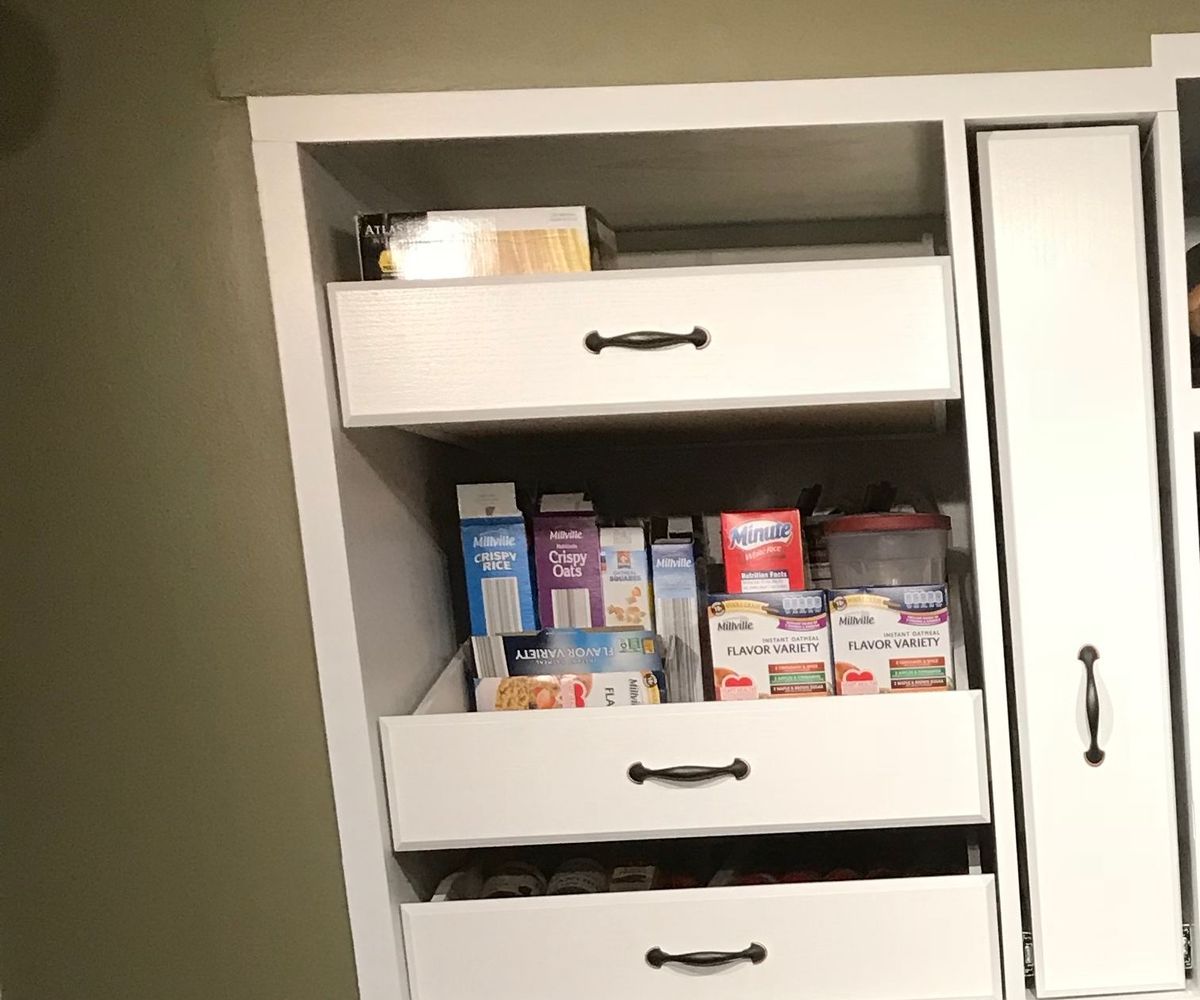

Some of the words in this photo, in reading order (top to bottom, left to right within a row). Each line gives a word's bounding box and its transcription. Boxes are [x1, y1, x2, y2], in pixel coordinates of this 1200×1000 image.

[473, 534, 516, 548] Millville
[549, 530, 584, 540] Millville
[731, 523, 791, 548] Minute
[474, 551, 517, 563] CRISPY
[549, 550, 588, 566] Crispy
[655, 557, 692, 568] Millville
[482, 561, 513, 571] RICE
[552, 564, 583, 577] Oats
[717, 620, 754, 631] Millville
[838, 615, 875, 626] Millville
[727, 644, 771, 656] FLAVOR
[773, 642, 820, 654] VARIETY
[848, 639, 892, 651] FLAVOR
[893, 637, 941, 649] VARIETY
[515, 648, 567, 660] VARIETY
[567, 646, 615, 658] FLAVOR
